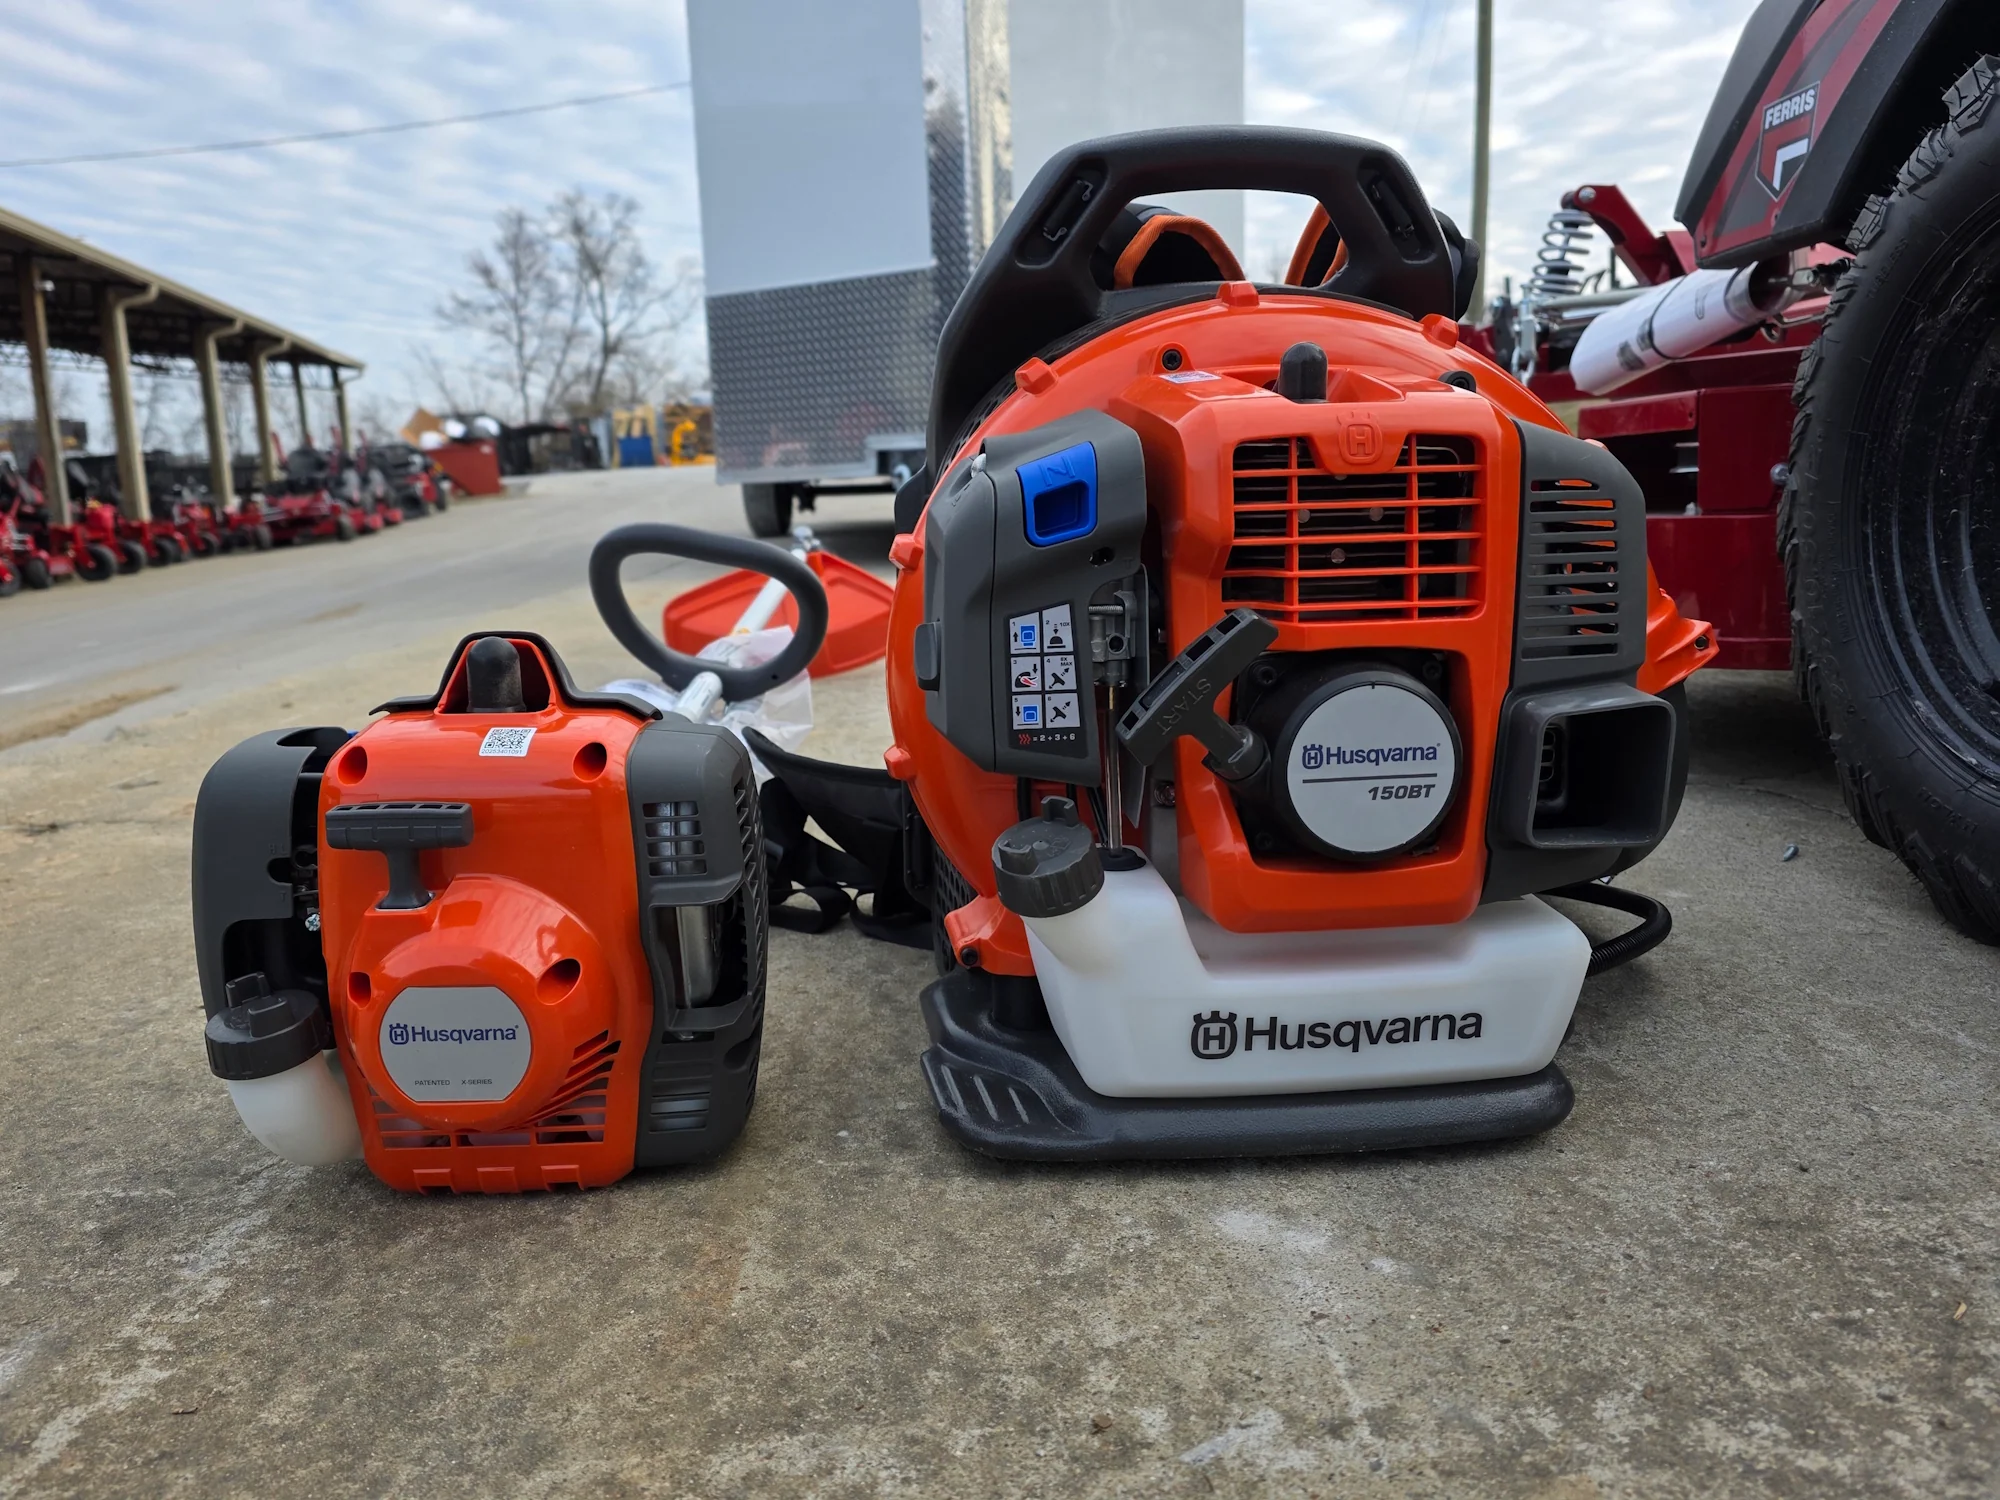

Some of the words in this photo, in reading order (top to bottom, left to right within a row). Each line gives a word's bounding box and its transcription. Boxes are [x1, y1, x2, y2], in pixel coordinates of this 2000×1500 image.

[1765, 89, 1815, 130] FERRIS
[1156, 678, 1212, 736] START
[1054, 733, 1060, 741] 3
[1326, 746, 1437, 766] Husqvarna
[1368, 784, 1436, 800] 150BT
[411, 1026, 516, 1044] Husqvarna
[1244, 1011, 1483, 1052] Husqvarna
